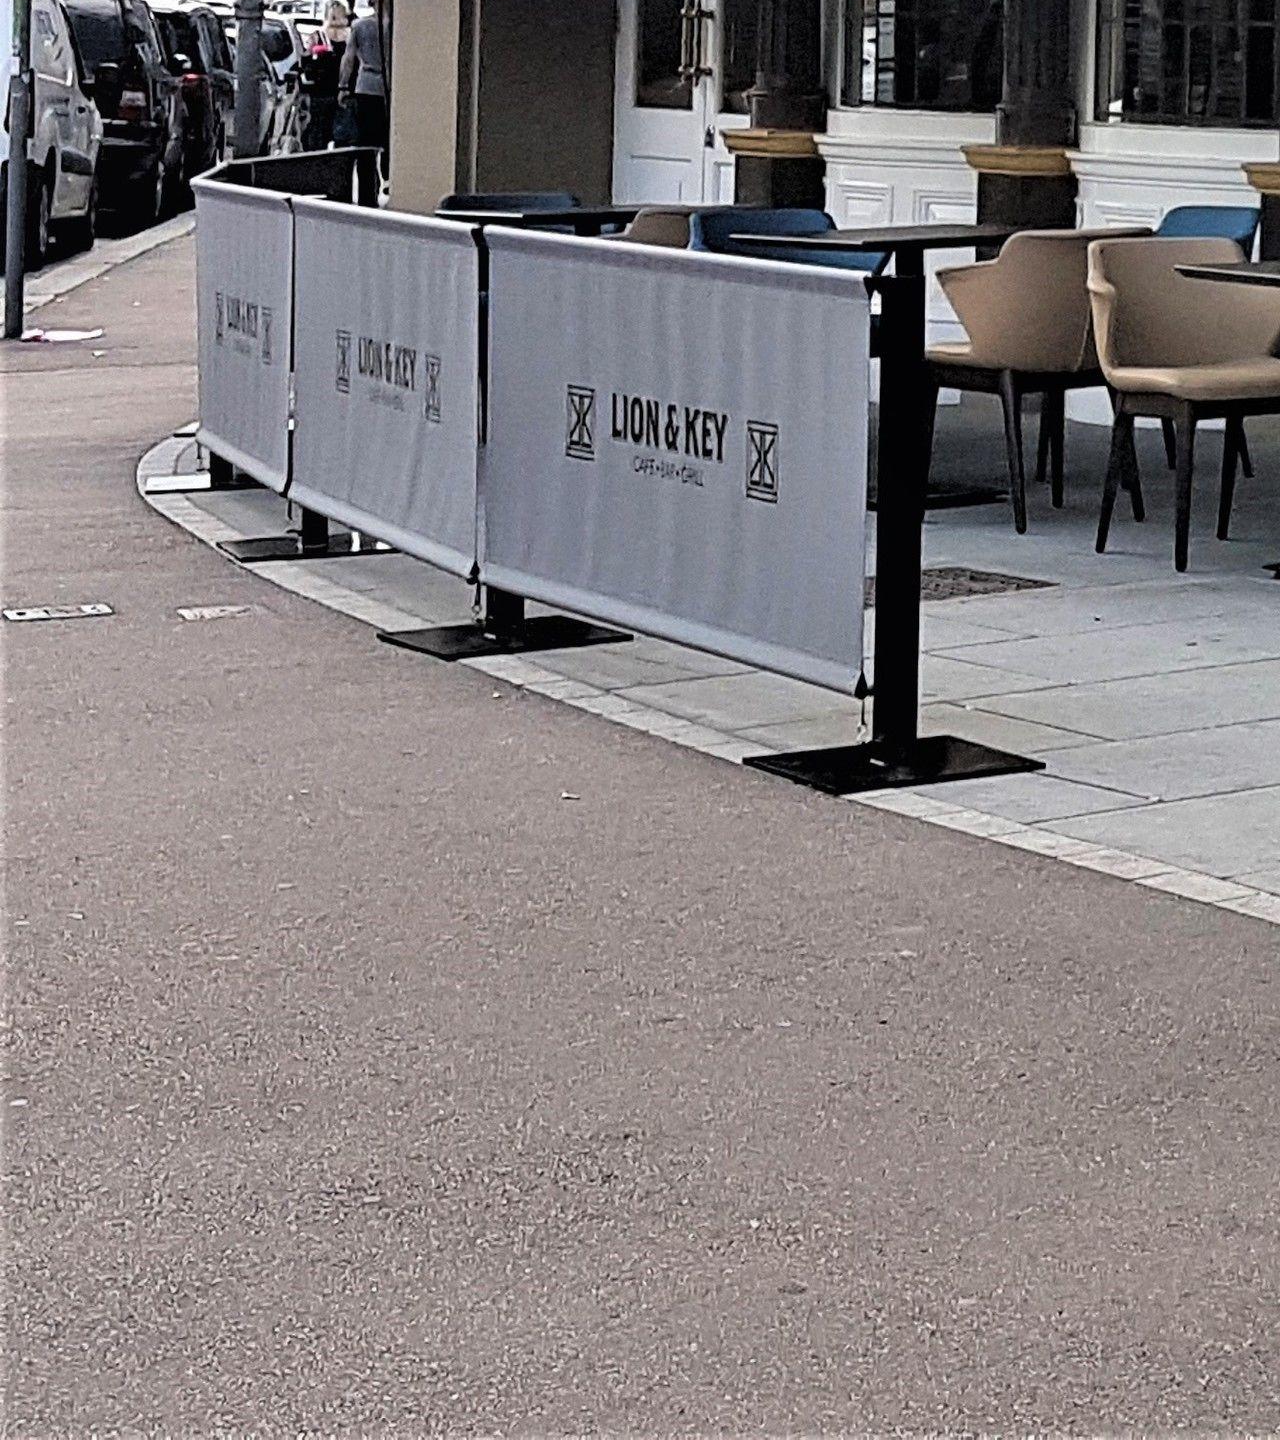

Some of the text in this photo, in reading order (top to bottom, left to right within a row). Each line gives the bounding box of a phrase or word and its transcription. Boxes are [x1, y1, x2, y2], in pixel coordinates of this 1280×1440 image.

[611, 392, 729, 463] LION & KEY
